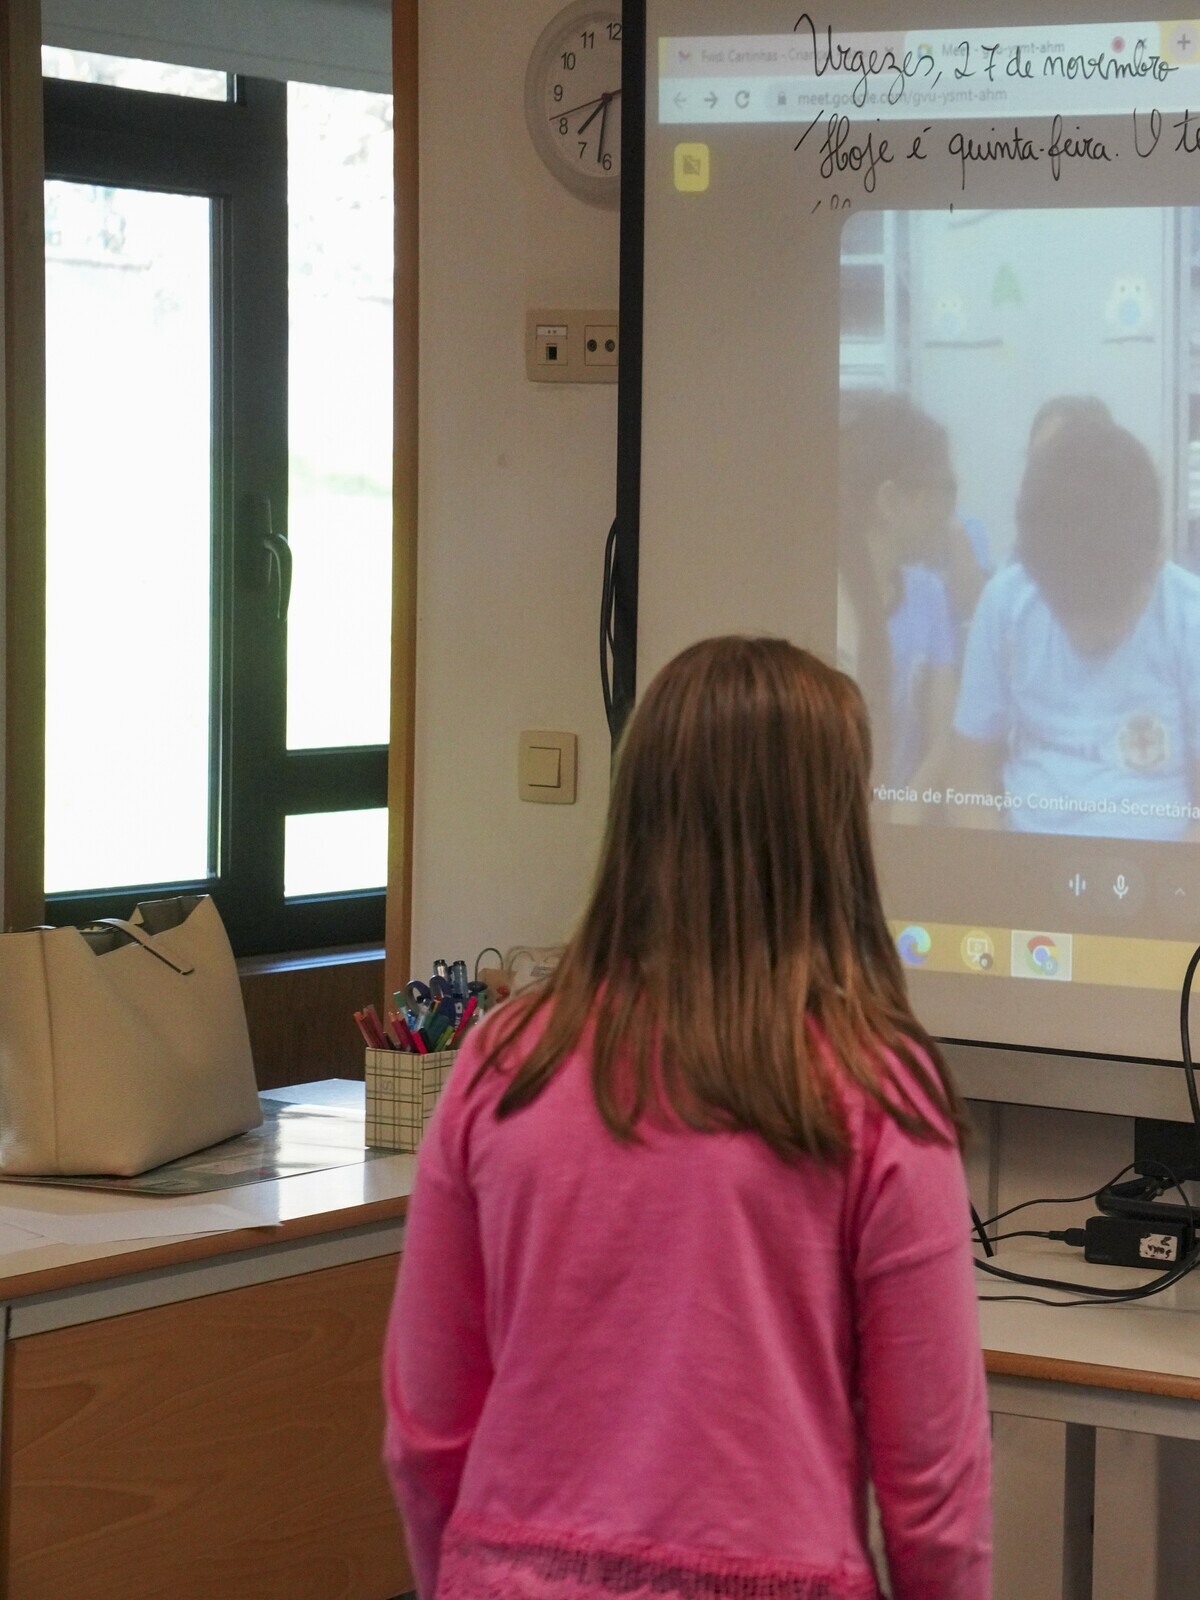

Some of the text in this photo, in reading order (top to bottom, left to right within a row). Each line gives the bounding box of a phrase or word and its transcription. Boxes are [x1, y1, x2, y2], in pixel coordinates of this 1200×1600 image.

[580, 31, 595, 49] 11
[606, 22, 622, 40] 12
[561, 52, 576, 70] 10
[955, 41, 1000, 82] 27
[1006, 46, 1034, 78] de
[1043, 38, 1179, 82] novembro
[554, 85, 563, 102] 9
[559, 118, 568, 135] 8
[578, 142, 587, 159] 7
[820, 112, 894, 193] Hoje
[906, 126, 932, 159] é
[602, 153, 612, 171] 6
[922, 787, 942, 803] de
[946, 788, 1022, 811] Formação
[1027, 792, 1116, 815] Continuada
[1121, 798, 1200, 820] Secretária
